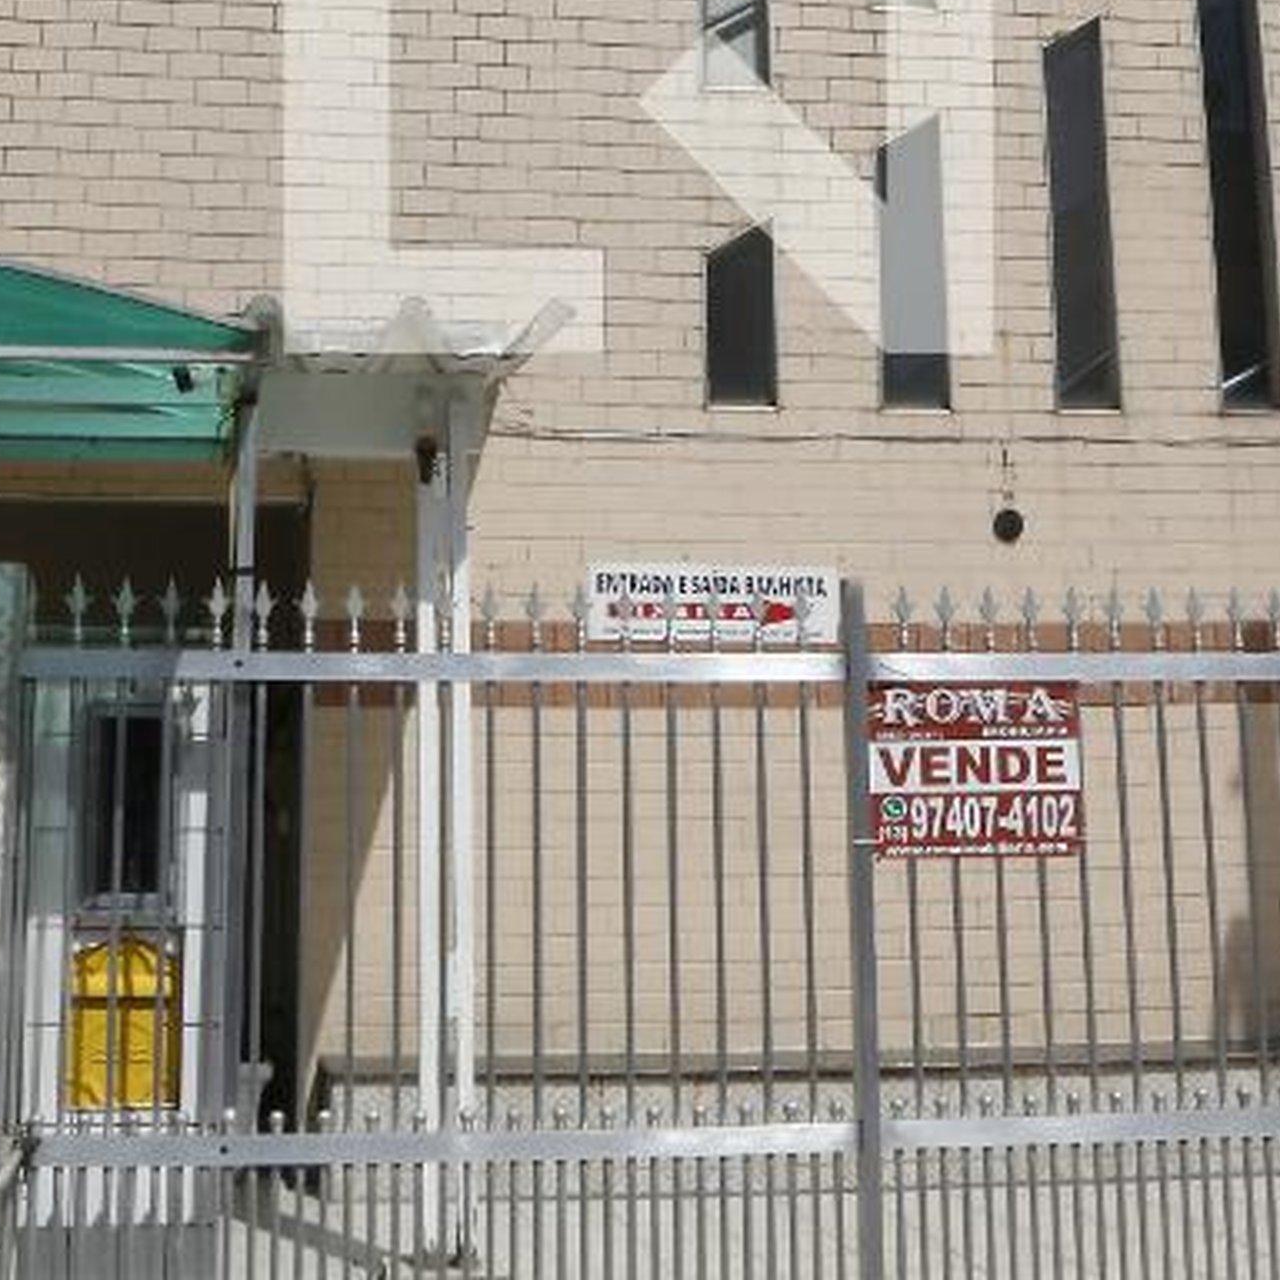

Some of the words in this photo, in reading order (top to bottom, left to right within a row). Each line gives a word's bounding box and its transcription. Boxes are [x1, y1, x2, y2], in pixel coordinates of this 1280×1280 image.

[882, 687, 1065, 725] ROMA
[877, 746, 1068, 788] VENDE
[910, 794, 1078, 839] 97407-4102
